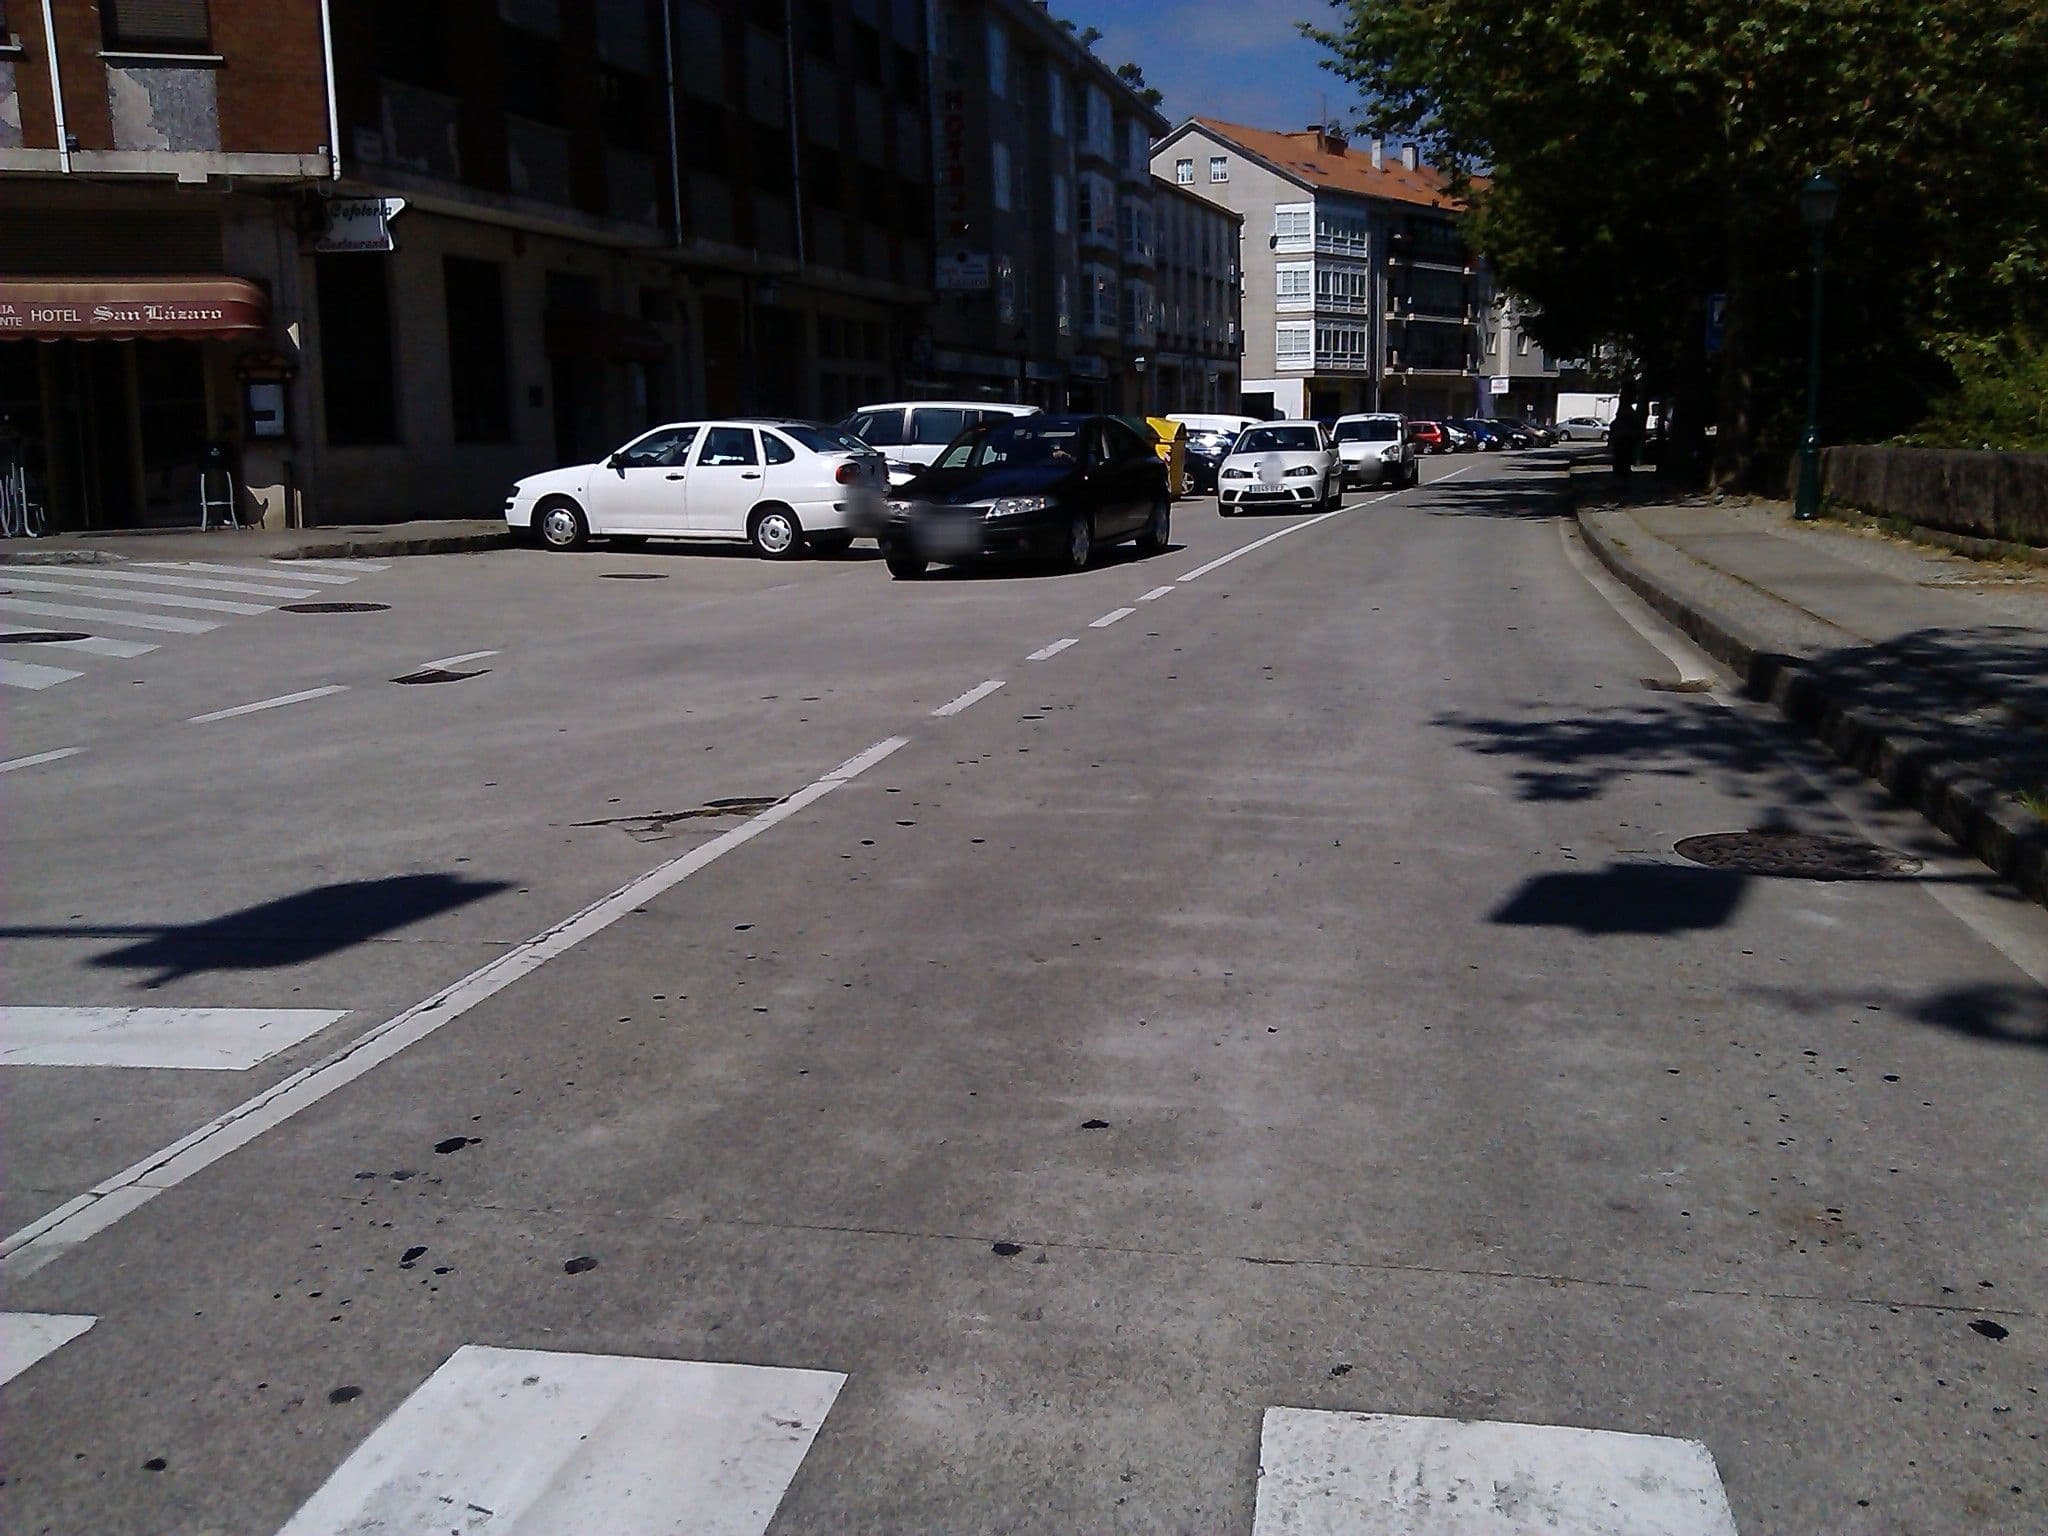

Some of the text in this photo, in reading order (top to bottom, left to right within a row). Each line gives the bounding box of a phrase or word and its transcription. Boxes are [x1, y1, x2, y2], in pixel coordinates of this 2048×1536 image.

[30, 304, 223, 323] HOTEL San Lázaro
